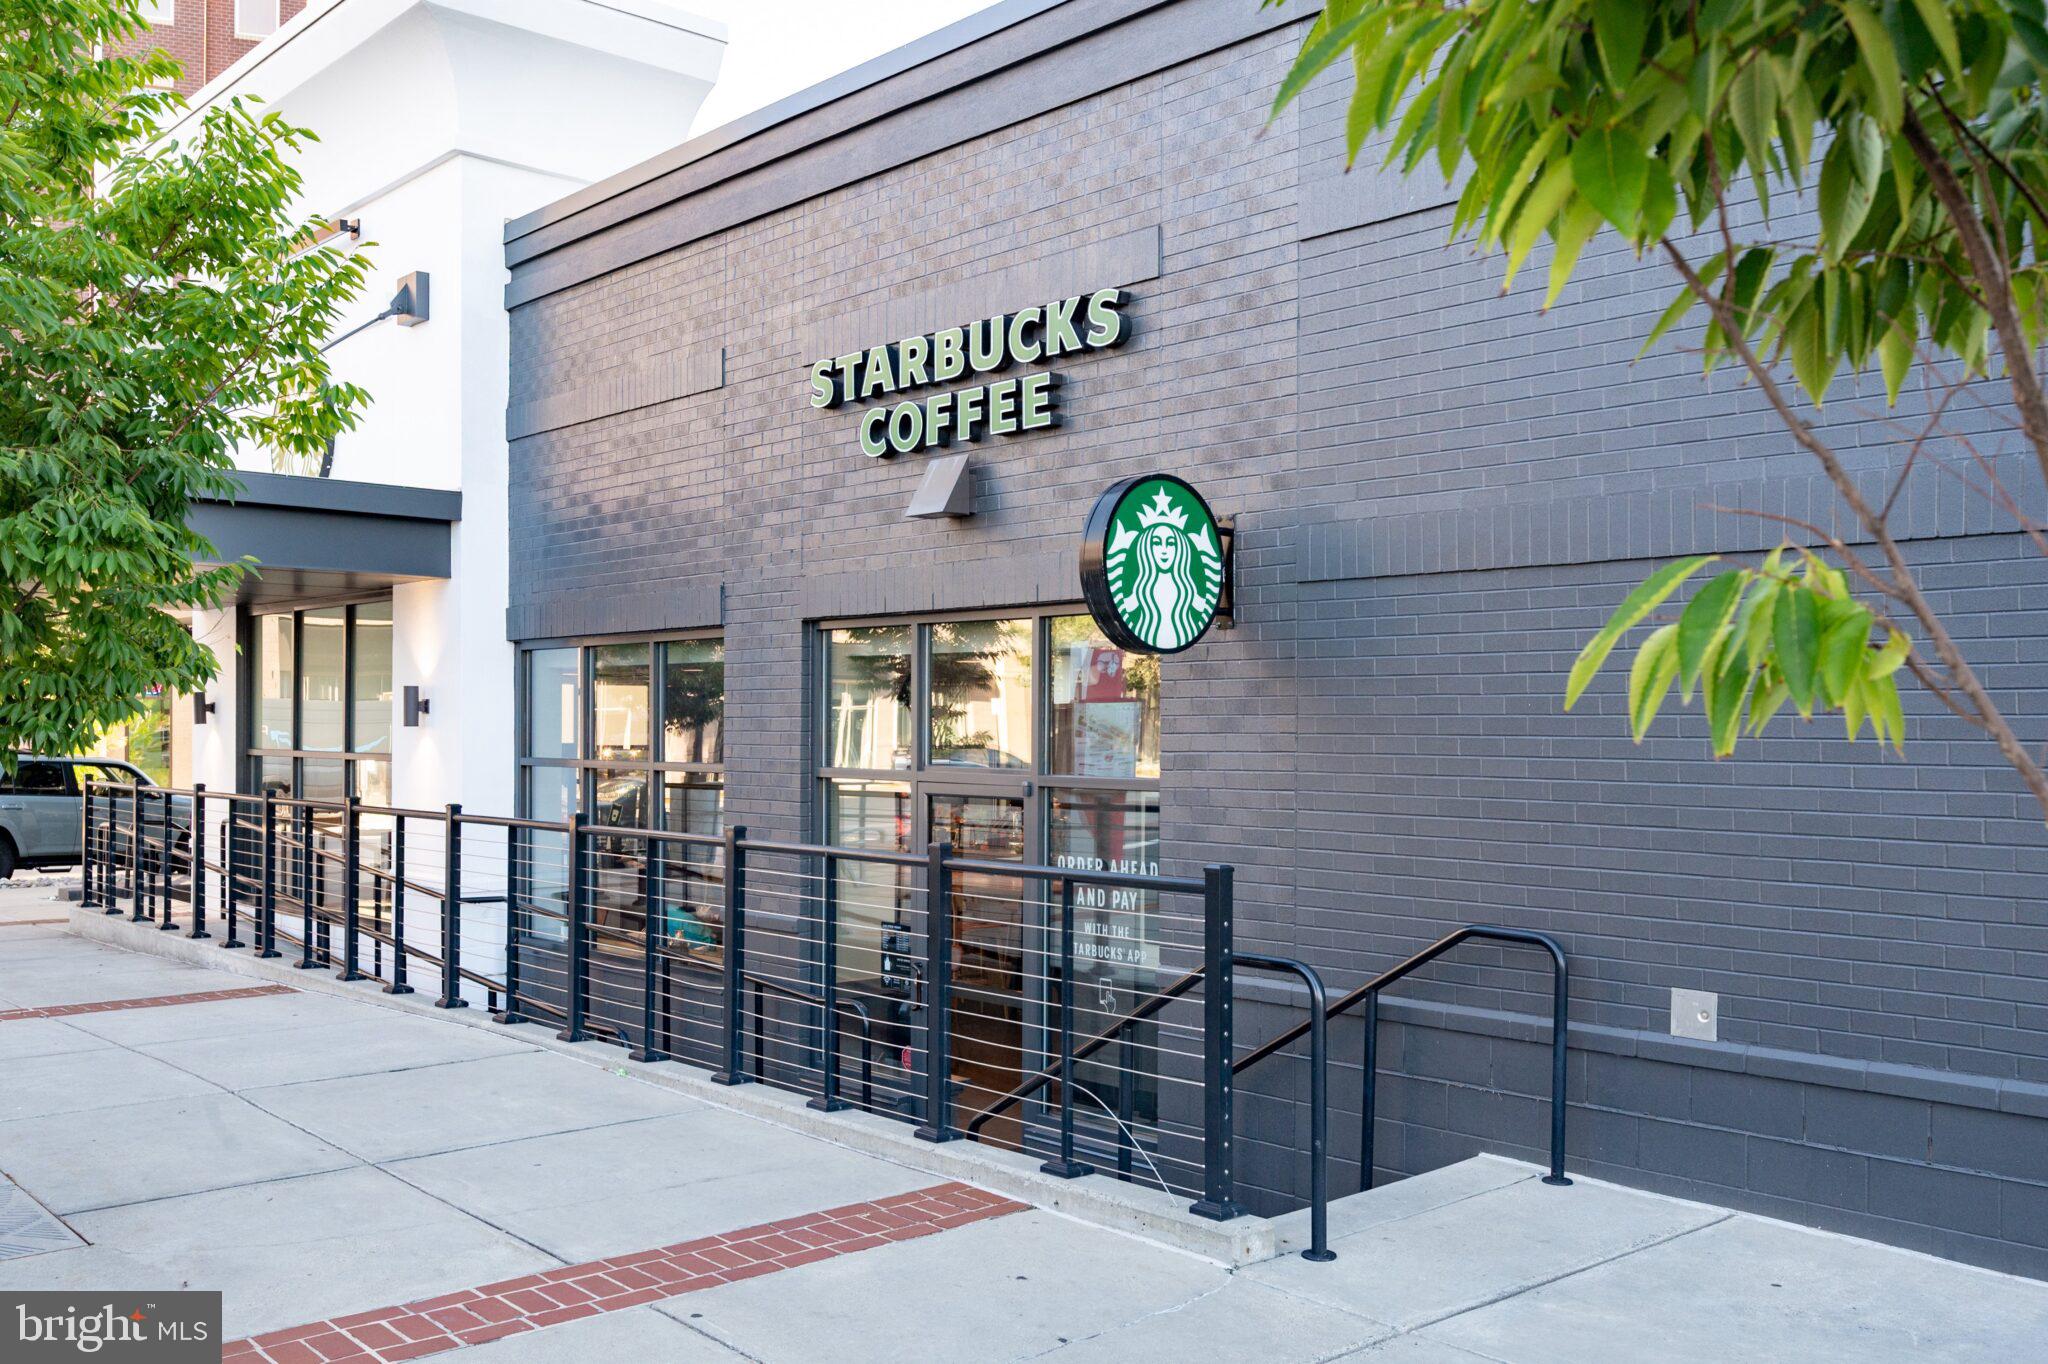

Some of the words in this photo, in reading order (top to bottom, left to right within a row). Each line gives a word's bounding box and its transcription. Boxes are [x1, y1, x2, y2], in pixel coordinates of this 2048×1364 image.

[810, 288, 1121, 408] STARBUCKS
[860, 371, 1051, 457] COFFEE
[1057, 855, 1103, 871] ORDER
[1110, 859, 1159, 876] AHEAD
[1076, 887, 1105, 907] AND
[1112, 890, 1137, 910] PAY
[1084, 922, 1108, 935] WITH
[1112, 925, 1130, 937] THE
[1073, 942, 1123, 960] TARBUCKS
[1127, 949, 1147, 963] APP
